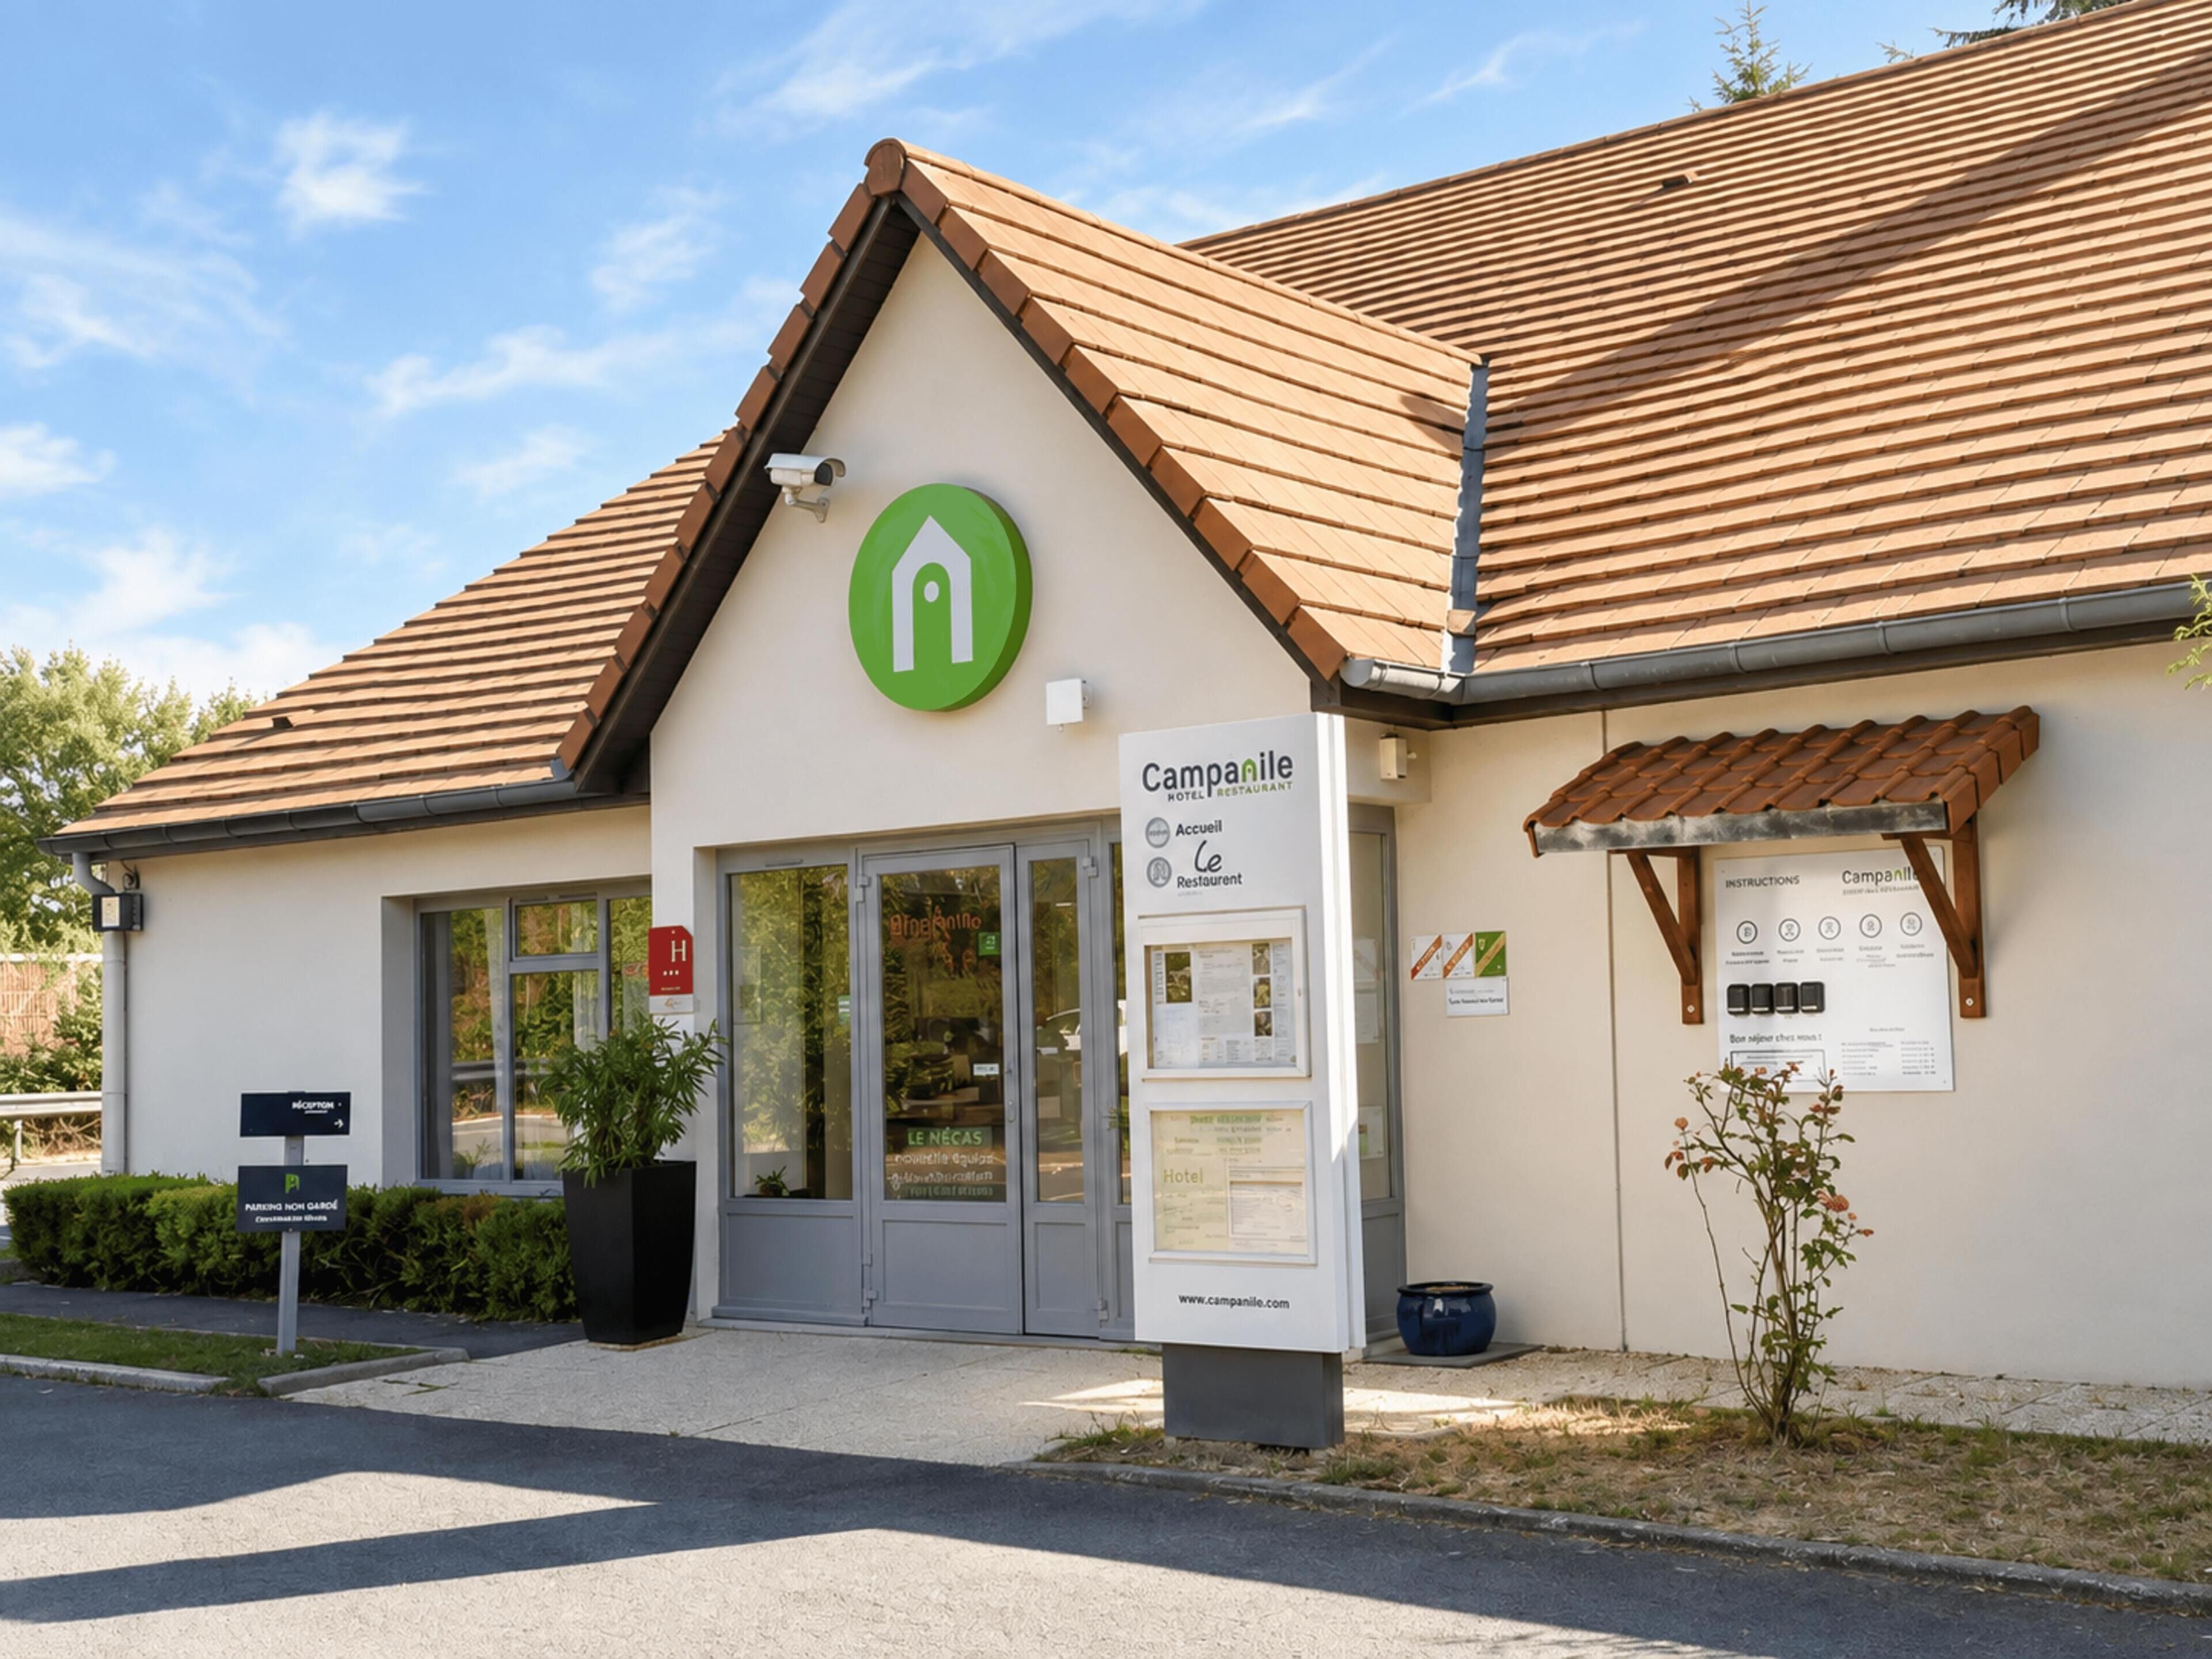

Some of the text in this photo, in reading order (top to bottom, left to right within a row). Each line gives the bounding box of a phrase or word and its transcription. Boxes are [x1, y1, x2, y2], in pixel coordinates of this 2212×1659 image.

[1142, 751, 1293, 798] Campanile
[1168, 782, 1292, 802] HOTEL RESTAURANT
[1176, 820, 1222, 836] Accueil
[1194, 840, 1222, 872] Le
[1725, 875, 1800, 888] INSTRUCTIONS
[672, 940, 686, 962] H
[908, 1131, 924, 1145] LE
[1163, 1168, 1203, 1183] Hotel
[1178, 1295, 1290, 1309] www.campanile.com
